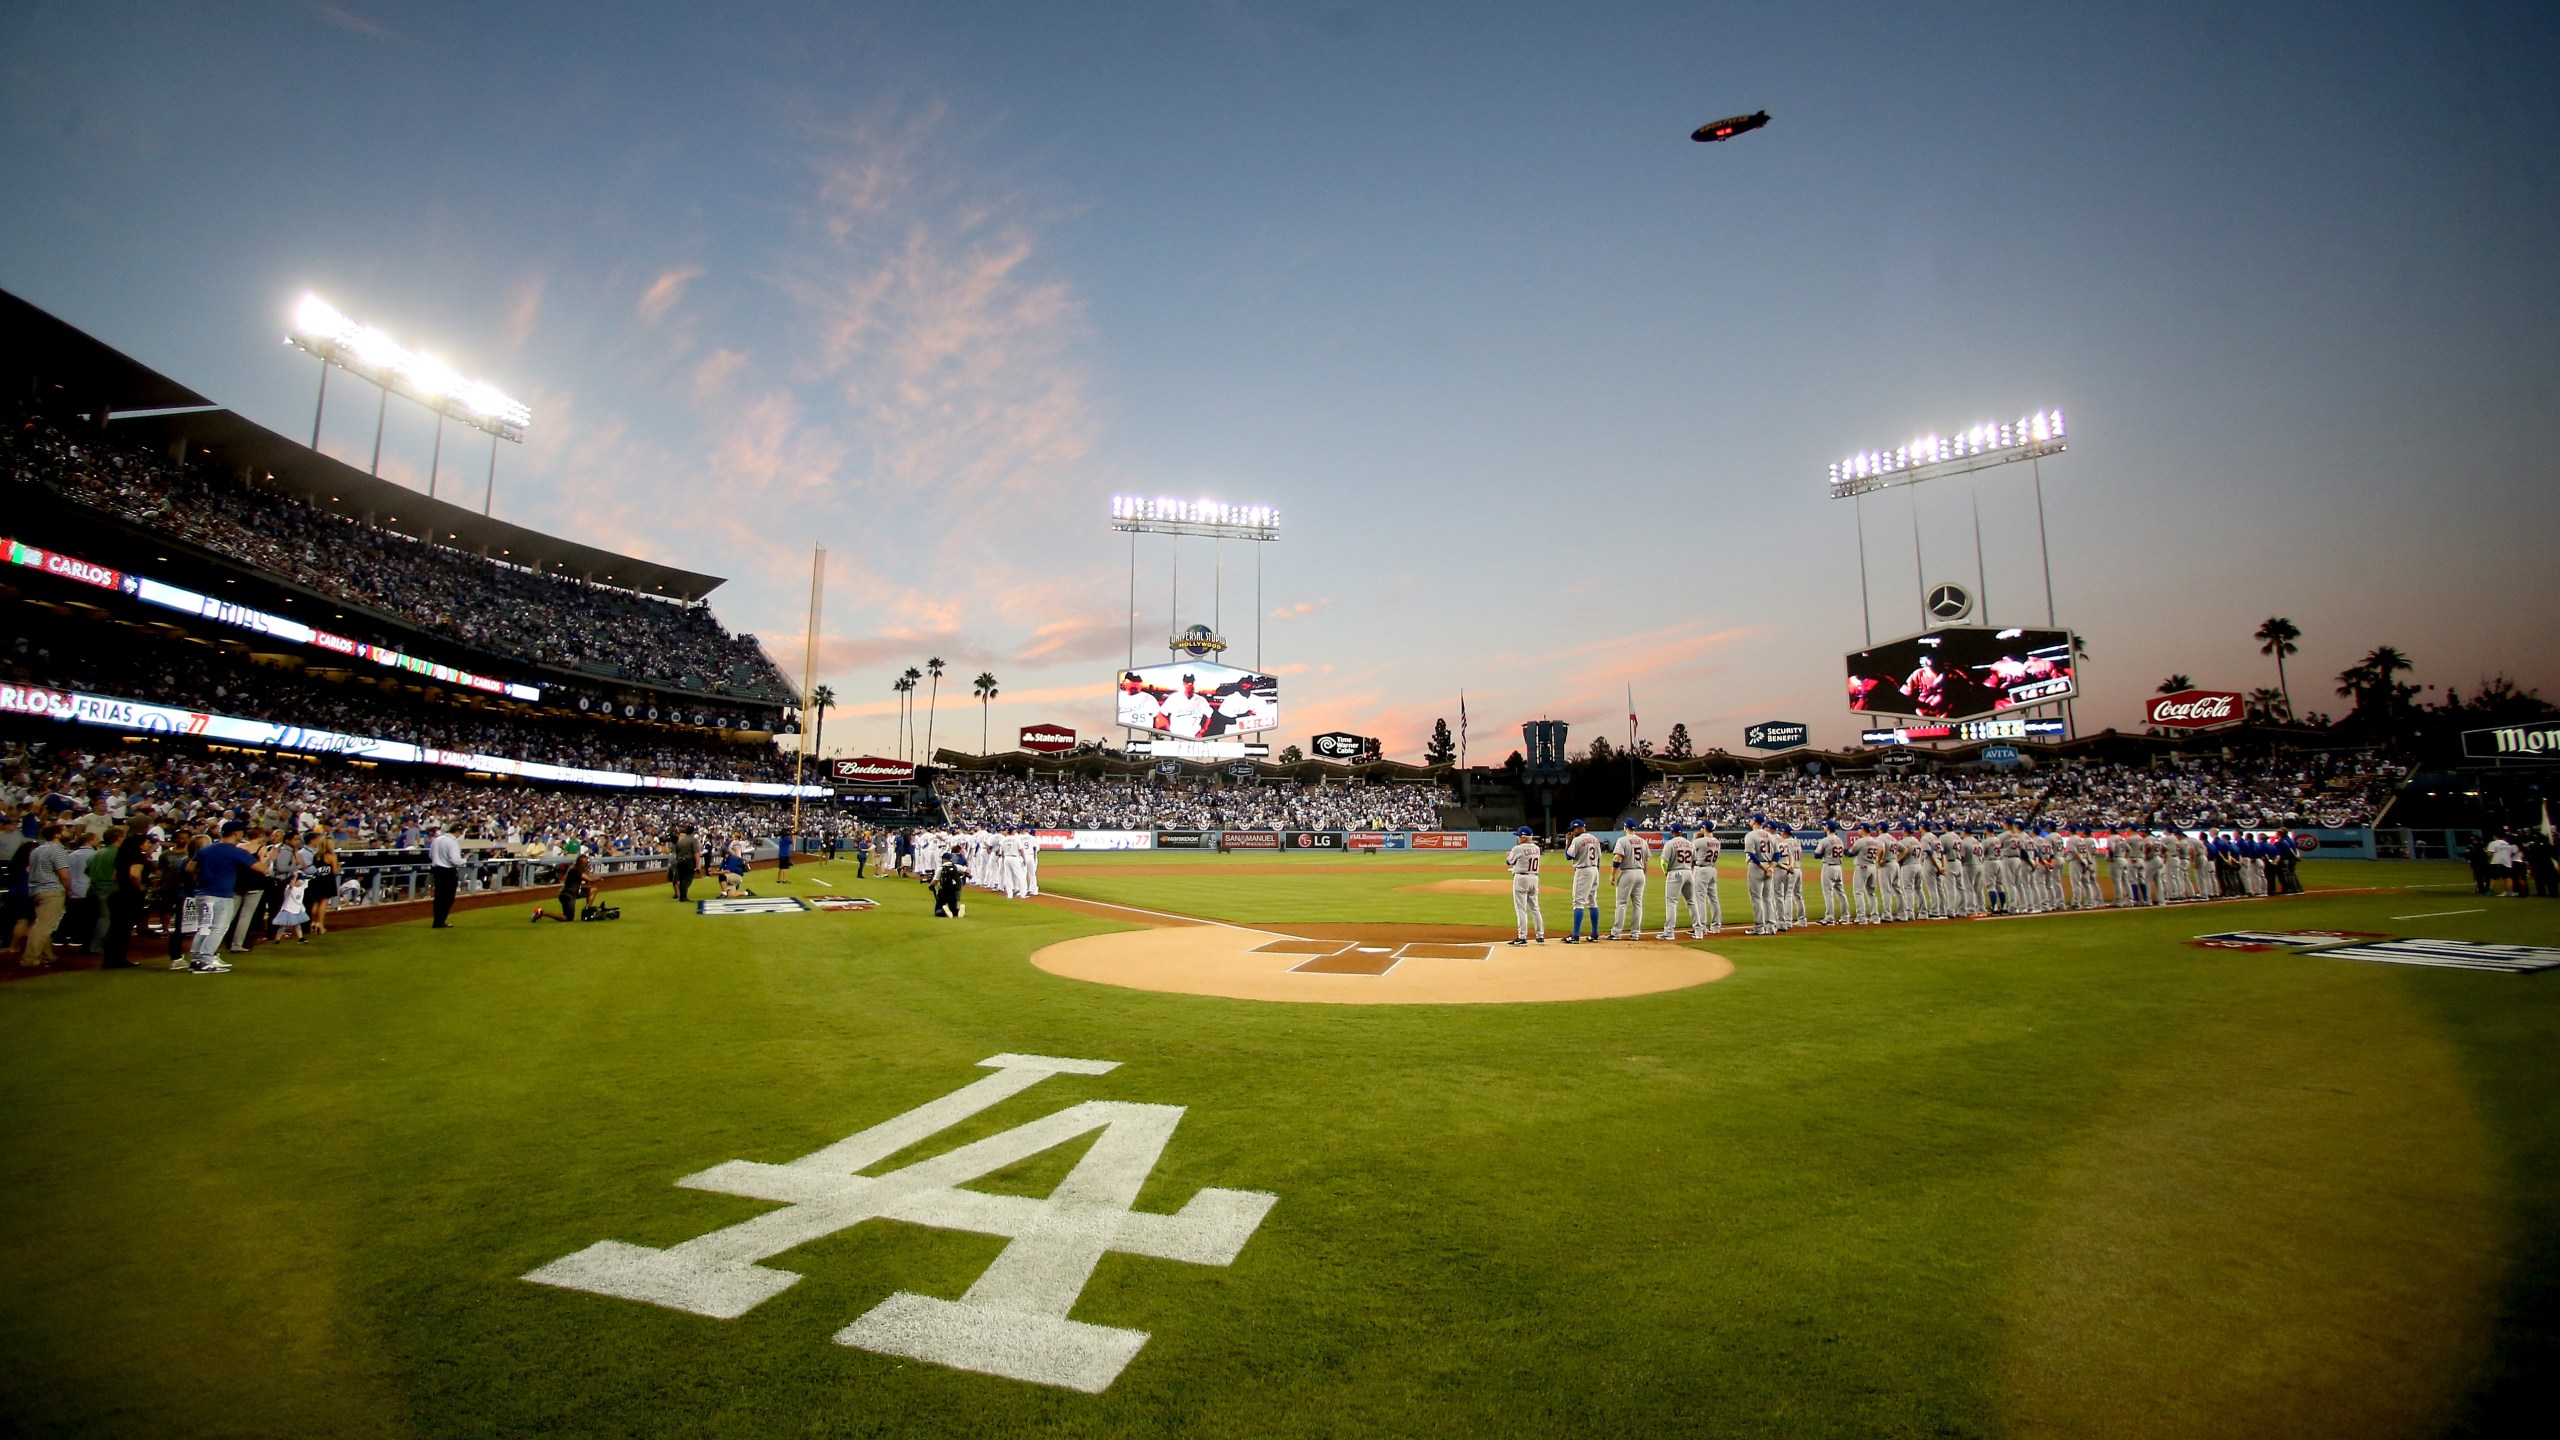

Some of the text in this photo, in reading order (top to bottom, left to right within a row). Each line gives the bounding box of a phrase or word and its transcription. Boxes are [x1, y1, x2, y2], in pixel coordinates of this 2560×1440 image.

[49, 556, 112, 586] CARLOS
[318, 633, 353, 653] CARLOS
[1171, 632, 1204, 643] UNIVERSAL
[1179, 642, 1221, 650] HOLLYWOOD
[473, 673, 501, 692] CARLOS
[79, 699, 133, 723] FRIAS
[188, 713, 210, 734] 77
[1767, 727, 1803, 735] SECURITY
[1985, 750, 2015, 759] AVITA
[838, 762, 912, 775] Budweiser
[1024, 842, 1029, 850] 9
[1136, 835, 1150, 845] 77
[1314, 836, 1331, 846] LG
[1760, 840, 1771, 853] 21
[1588, 846, 1596, 860] 3
[1634, 847, 1641, 861] 5
[1676, 850, 1692, 863] 52
[1705, 850, 1718, 863] 28
[1832, 846, 1843, 858] 62
[1528, 857, 1538, 872] 10
[521, 1053, 1279, 1393] LA
